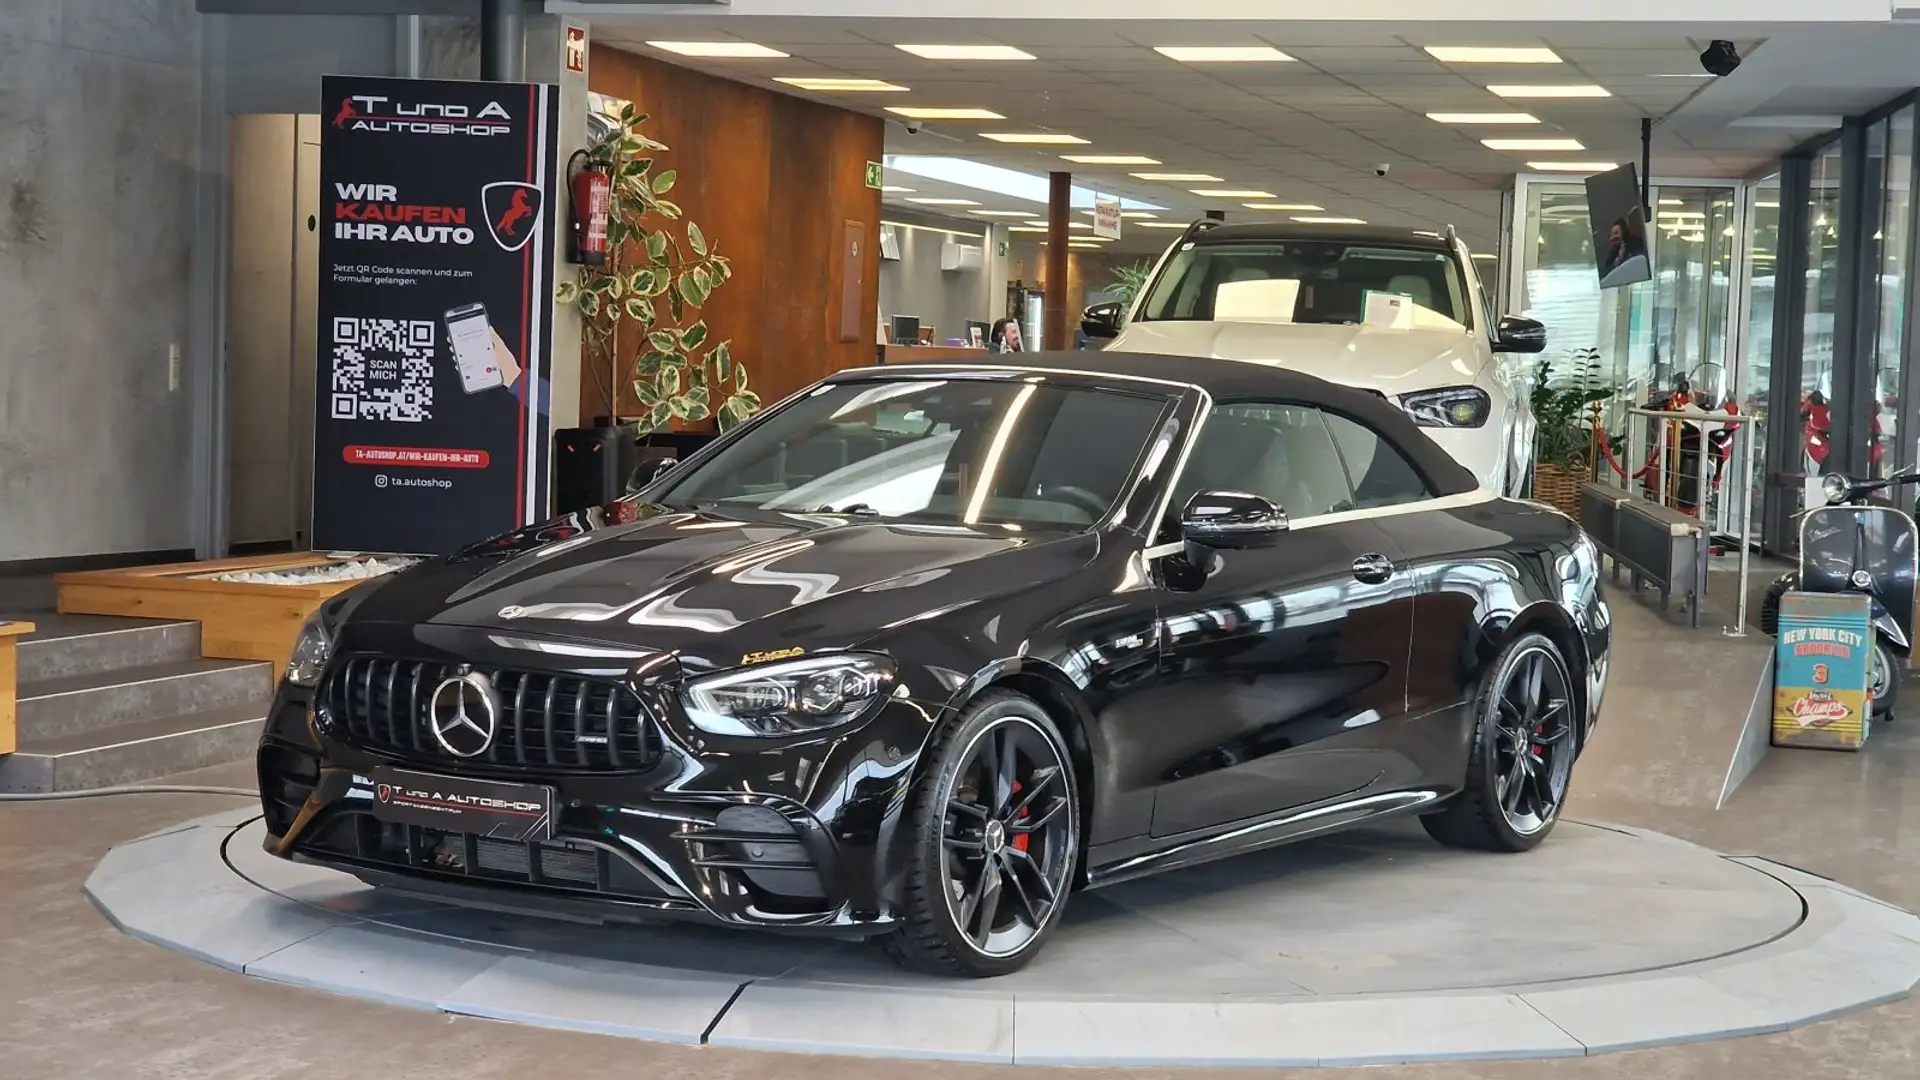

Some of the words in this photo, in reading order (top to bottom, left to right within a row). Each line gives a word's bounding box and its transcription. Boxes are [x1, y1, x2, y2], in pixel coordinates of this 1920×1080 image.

[352, 95, 388, 114] T
[475, 101, 511, 119] A
[351, 120, 511, 136] AUTOSHOP
[335, 182, 397, 201] WIR
[335, 202, 466, 224] KAUFEN
[335, 222, 388, 240] IHR
[390, 225, 475, 244] AUTO
[333, 263, 355, 273] Jetzt
[356, 265, 370, 274] QR
[371, 265, 394, 274] Code
[395, 267, 433, 276] scannen
[434, 268, 452, 276] und
[453, 269, 473, 277] zum
[333, 273, 373, 283] Formular
[374, 276, 418, 286] gelangen:
[370, 359, 397, 369] SCAN
[369, 370, 397, 380] MICH
[391, 476, 453, 489] ta.autoshop
[1783, 628, 1807, 644] NEW
[1809, 627, 1836, 641] YORK
[1837, 630, 1863, 647] CITY
[1812, 663, 1829, 684] 3
[393, 785, 403, 794] T
[432, 792, 443, 801] A
[446, 793, 541, 811] AUTOSHOP
